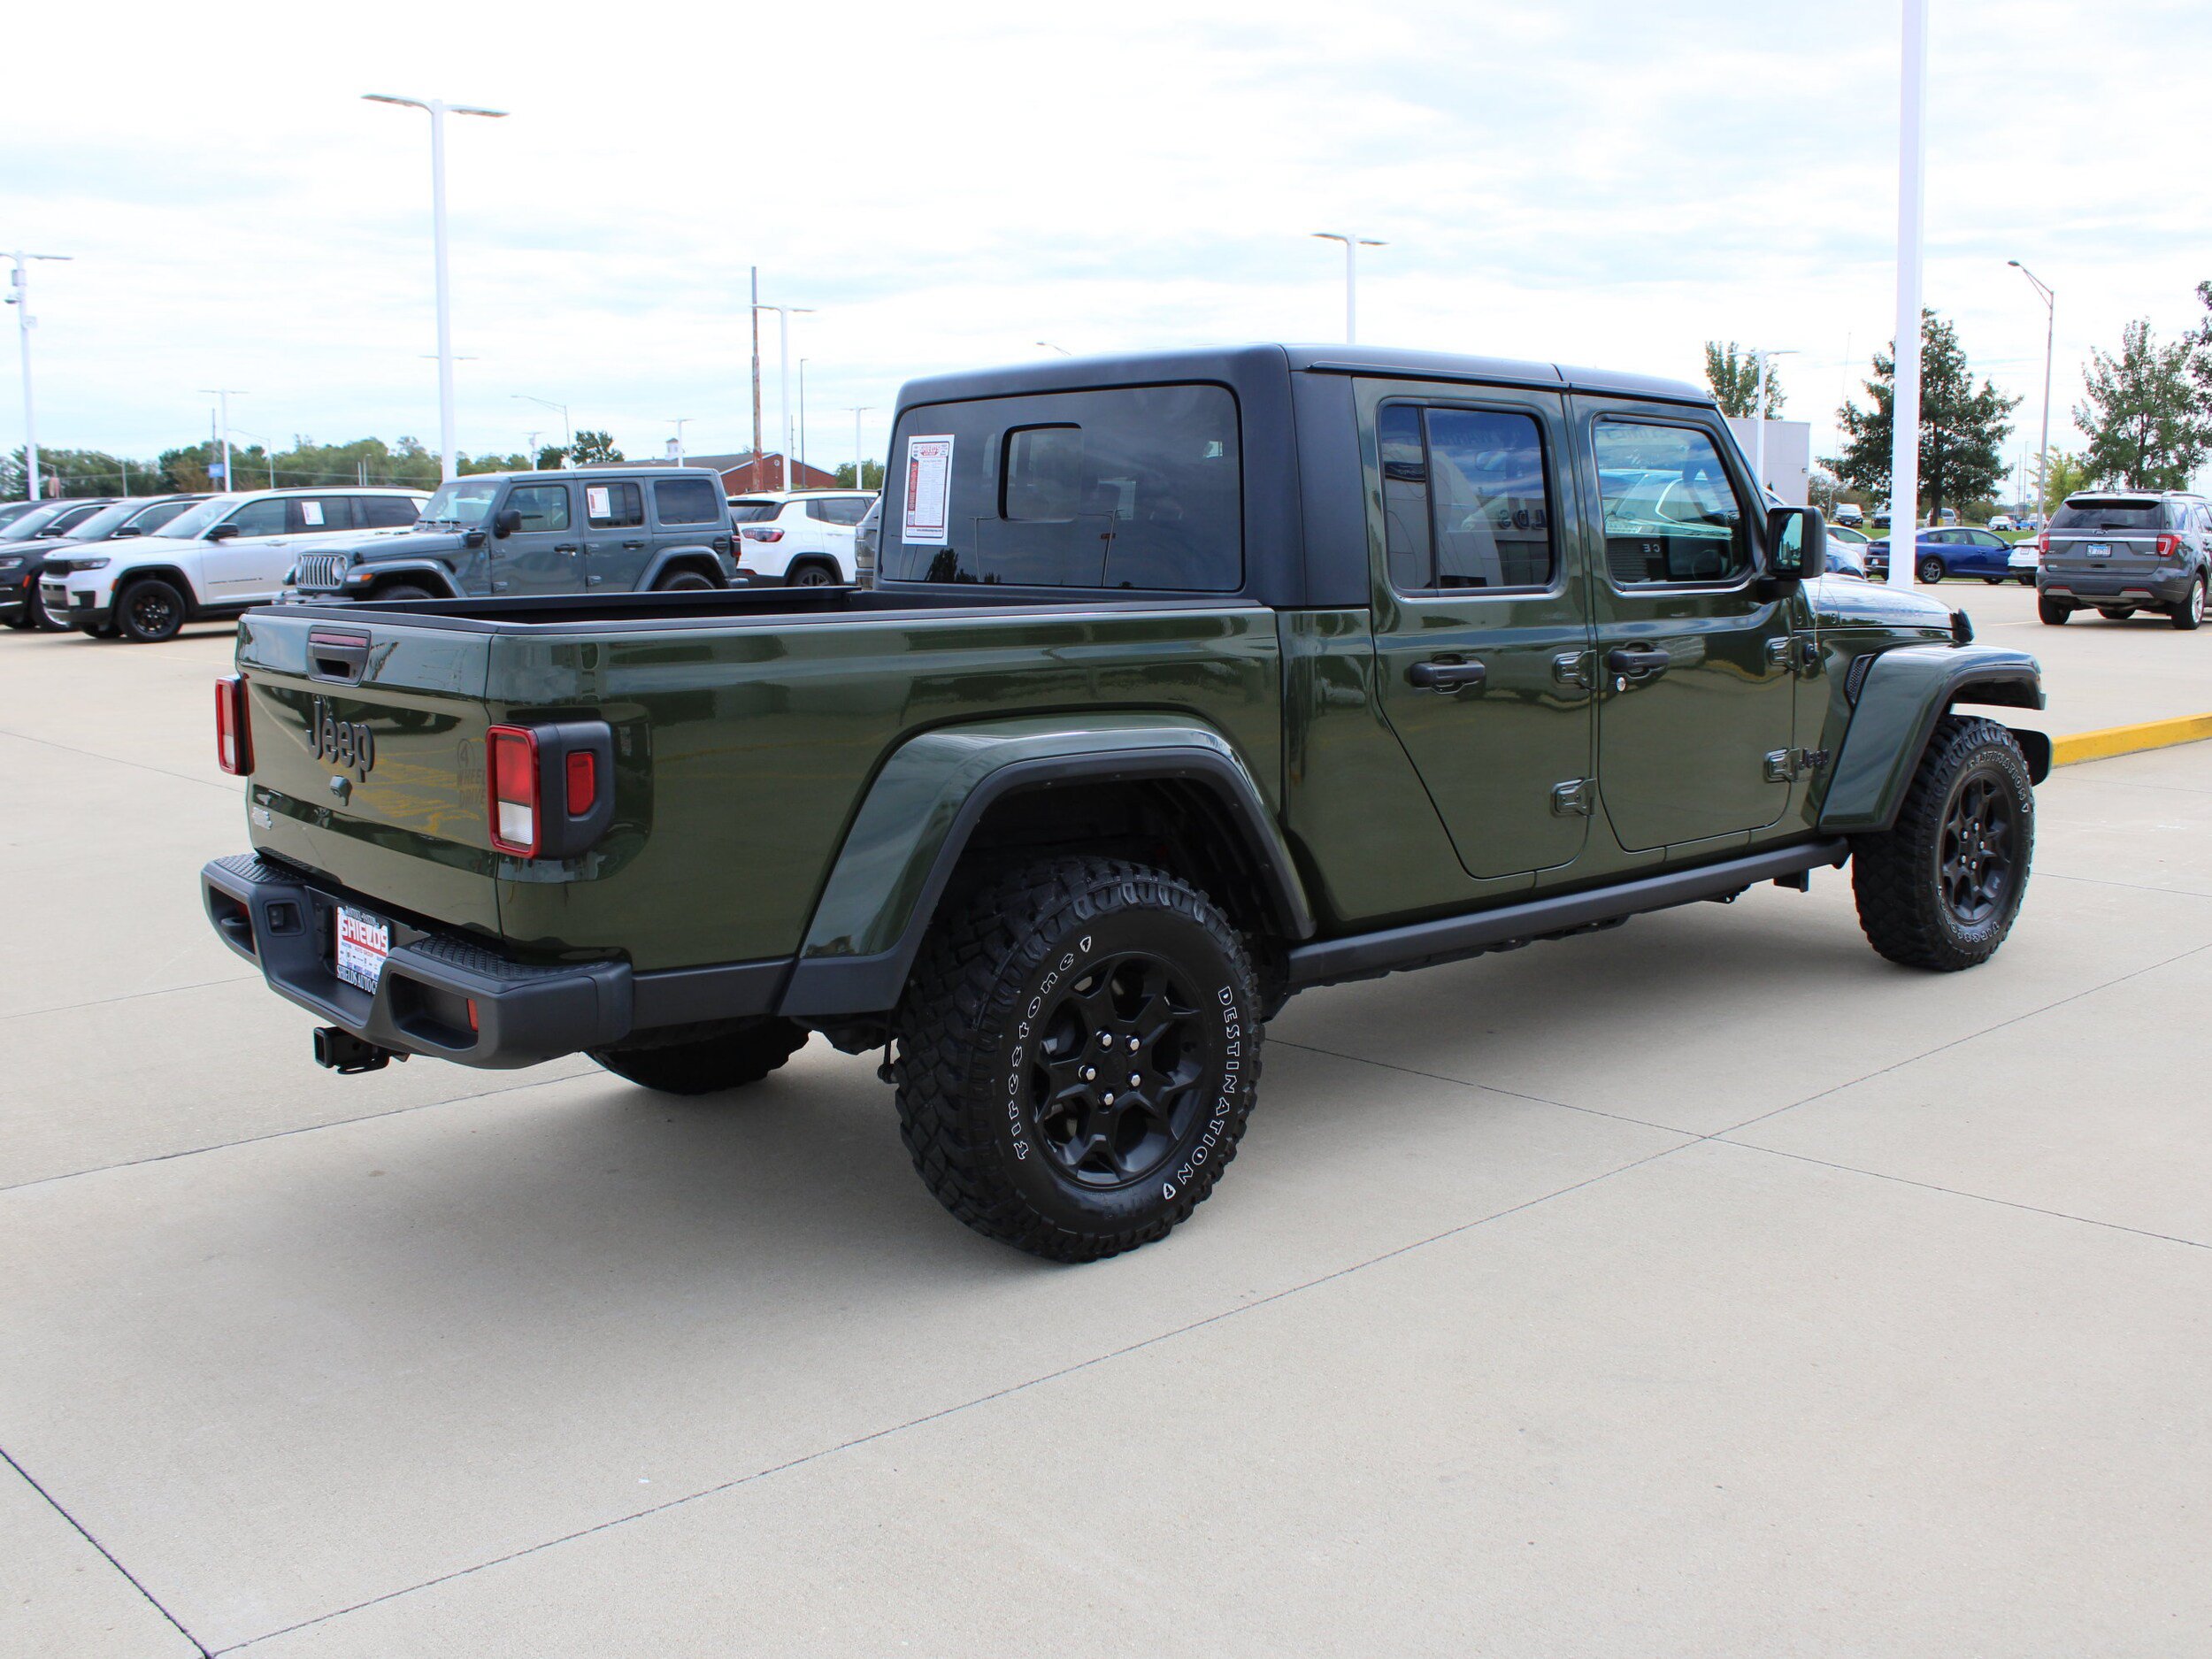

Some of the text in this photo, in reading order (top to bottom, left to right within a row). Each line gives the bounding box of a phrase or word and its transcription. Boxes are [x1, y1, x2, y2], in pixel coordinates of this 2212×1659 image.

[305, 701, 374, 783] Jeep
[341, 917, 388, 952] SHIELDS
[1177, 986, 1240, 1186] DESTINATION
